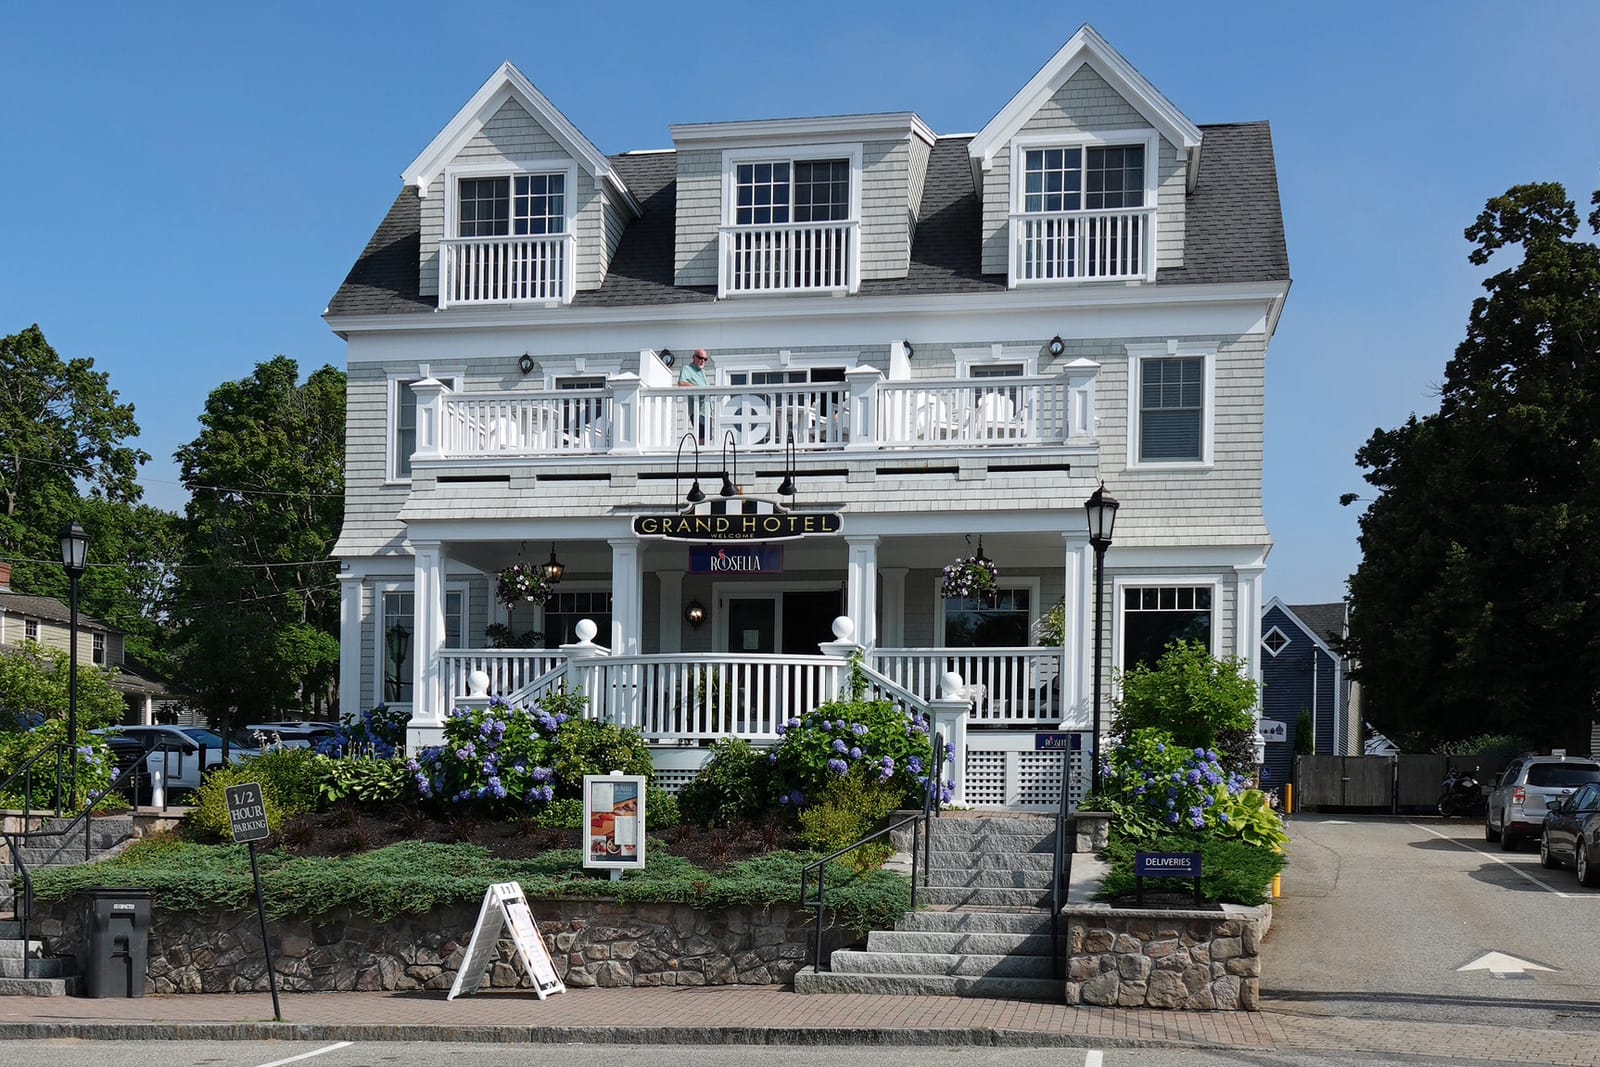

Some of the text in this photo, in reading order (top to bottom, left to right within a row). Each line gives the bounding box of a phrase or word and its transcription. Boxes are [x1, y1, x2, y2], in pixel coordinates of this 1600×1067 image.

[641, 516, 833, 534] GRAND HOTEL
[711, 555, 761, 571] ROSELLA
[233, 791, 255, 805] 1/2
[230, 805, 263, 821] HOUR
[233, 819, 266, 833] PARKING
[1145, 857, 1191, 866] DELIVERIES
